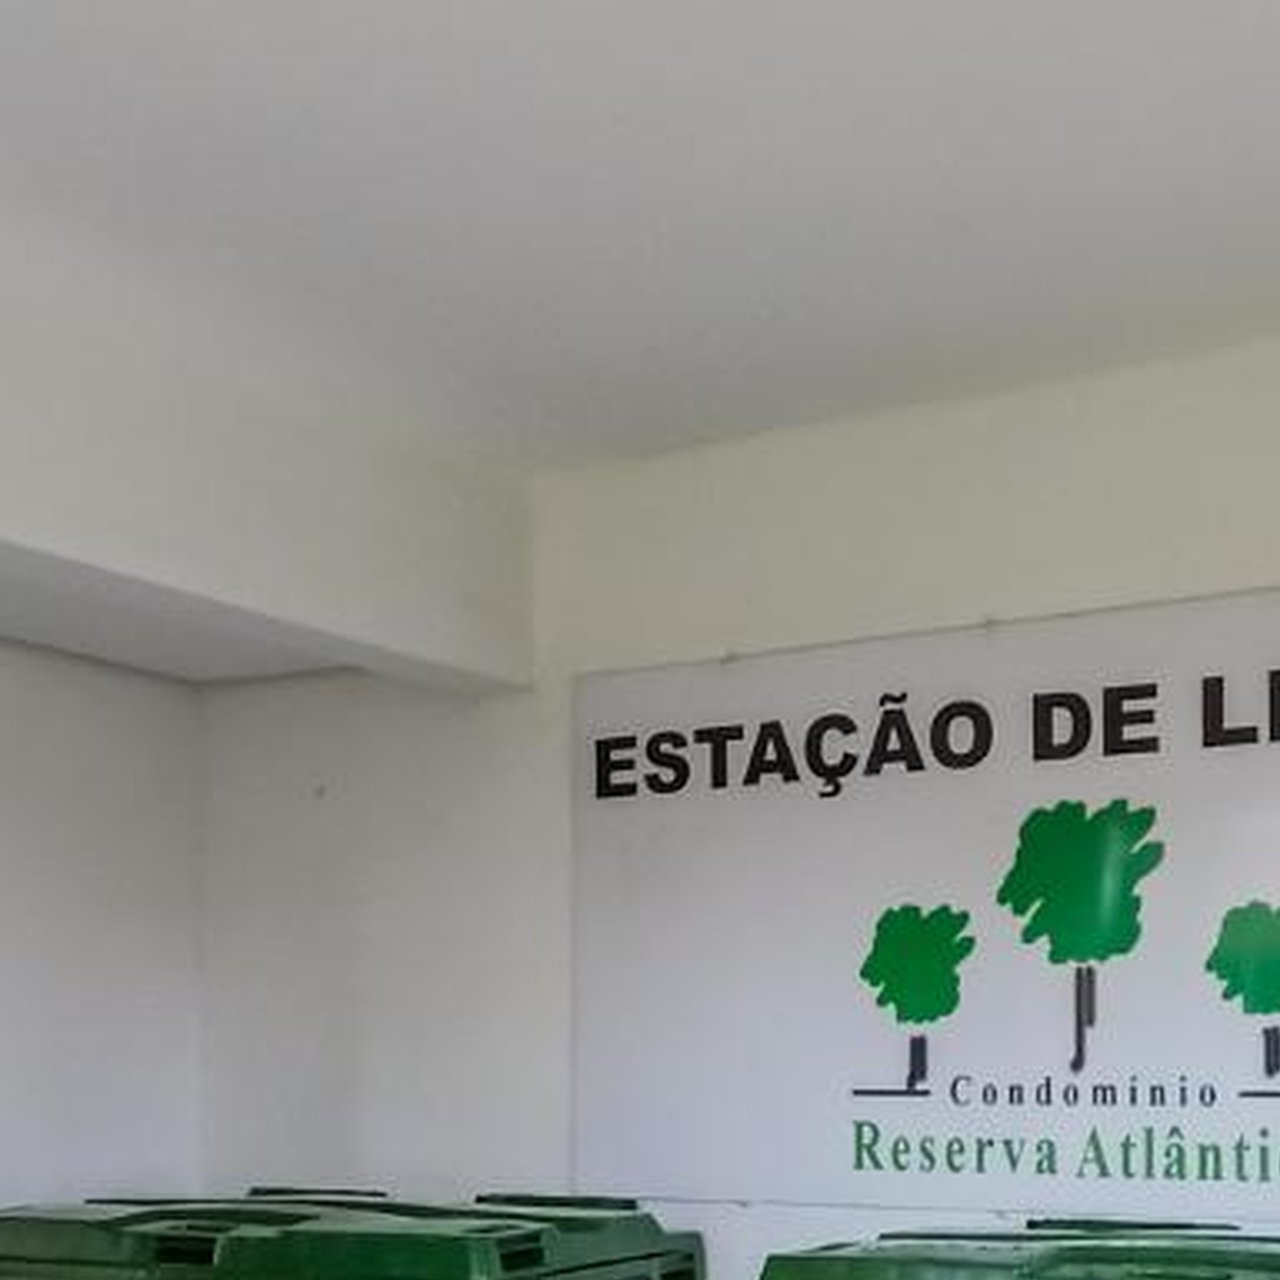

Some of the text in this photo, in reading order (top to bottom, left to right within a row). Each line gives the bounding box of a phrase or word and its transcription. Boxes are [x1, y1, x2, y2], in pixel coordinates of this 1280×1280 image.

[593, 690, 995, 799] ESTAÇÃO
[1031, 682, 1160, 764] DE
[852, 1119, 1058, 1175] Reserva
